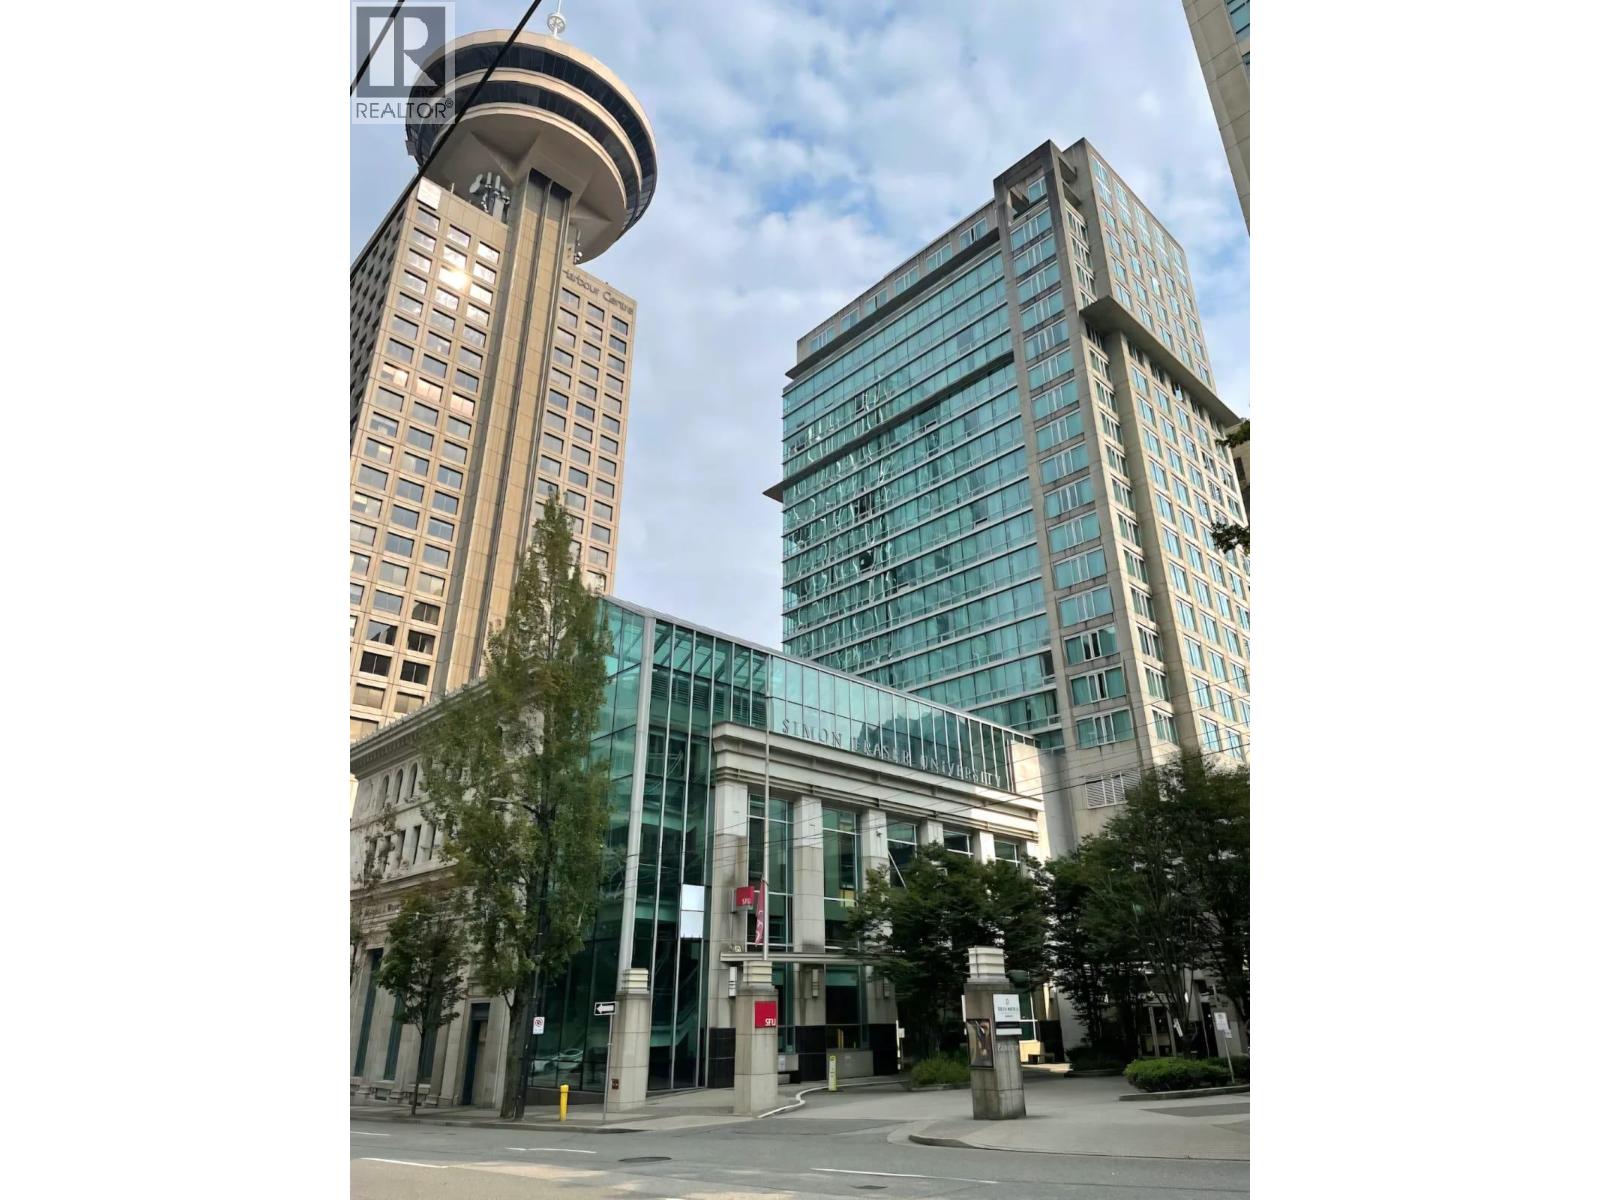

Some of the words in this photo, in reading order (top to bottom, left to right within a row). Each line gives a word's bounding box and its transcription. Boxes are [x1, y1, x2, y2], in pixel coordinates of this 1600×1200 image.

[602, 291, 634, 315] Centre
[782, 719, 842, 749] SIMON
[765, 1018, 776, 1027] SFU
